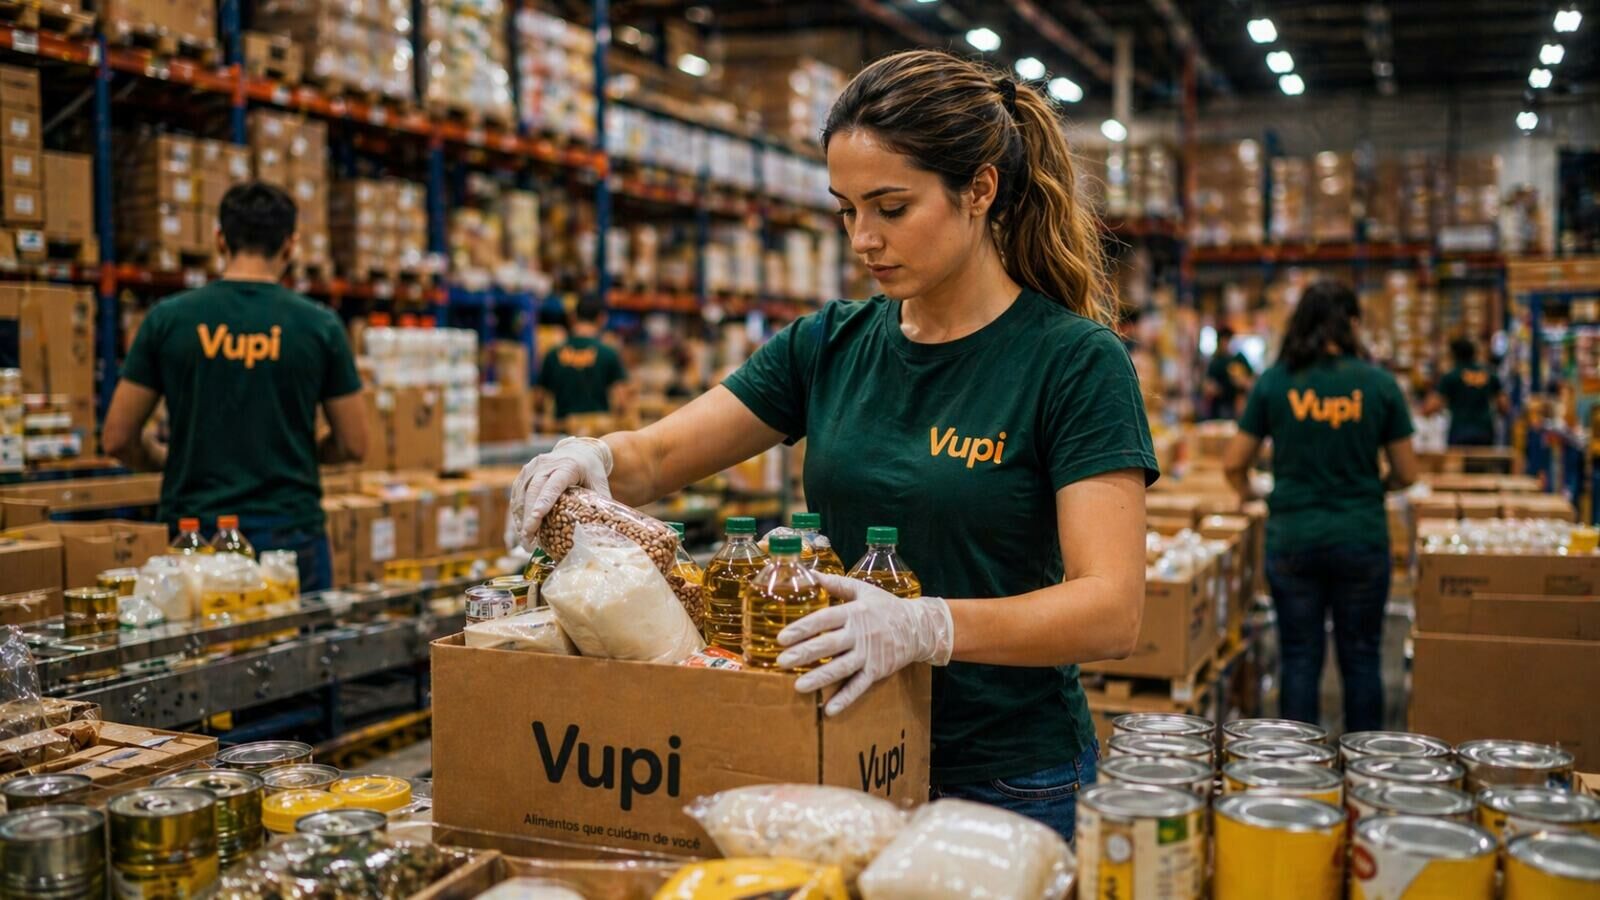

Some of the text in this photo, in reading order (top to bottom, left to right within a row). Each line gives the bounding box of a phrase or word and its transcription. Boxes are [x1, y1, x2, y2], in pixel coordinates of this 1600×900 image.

[197, 323, 282, 369] Vupi
[1287, 388, 1363, 430] Vupi
[930, 426, 1007, 469] Vupi
[532, 721, 682, 811] Vupi
[859, 728, 905, 797] Vupi
[524, 813, 580, 832] Alimentos
[582, 824, 604, 837] que
[607, 827, 650, 842] cuidam
[652, 832, 669, 846] de
